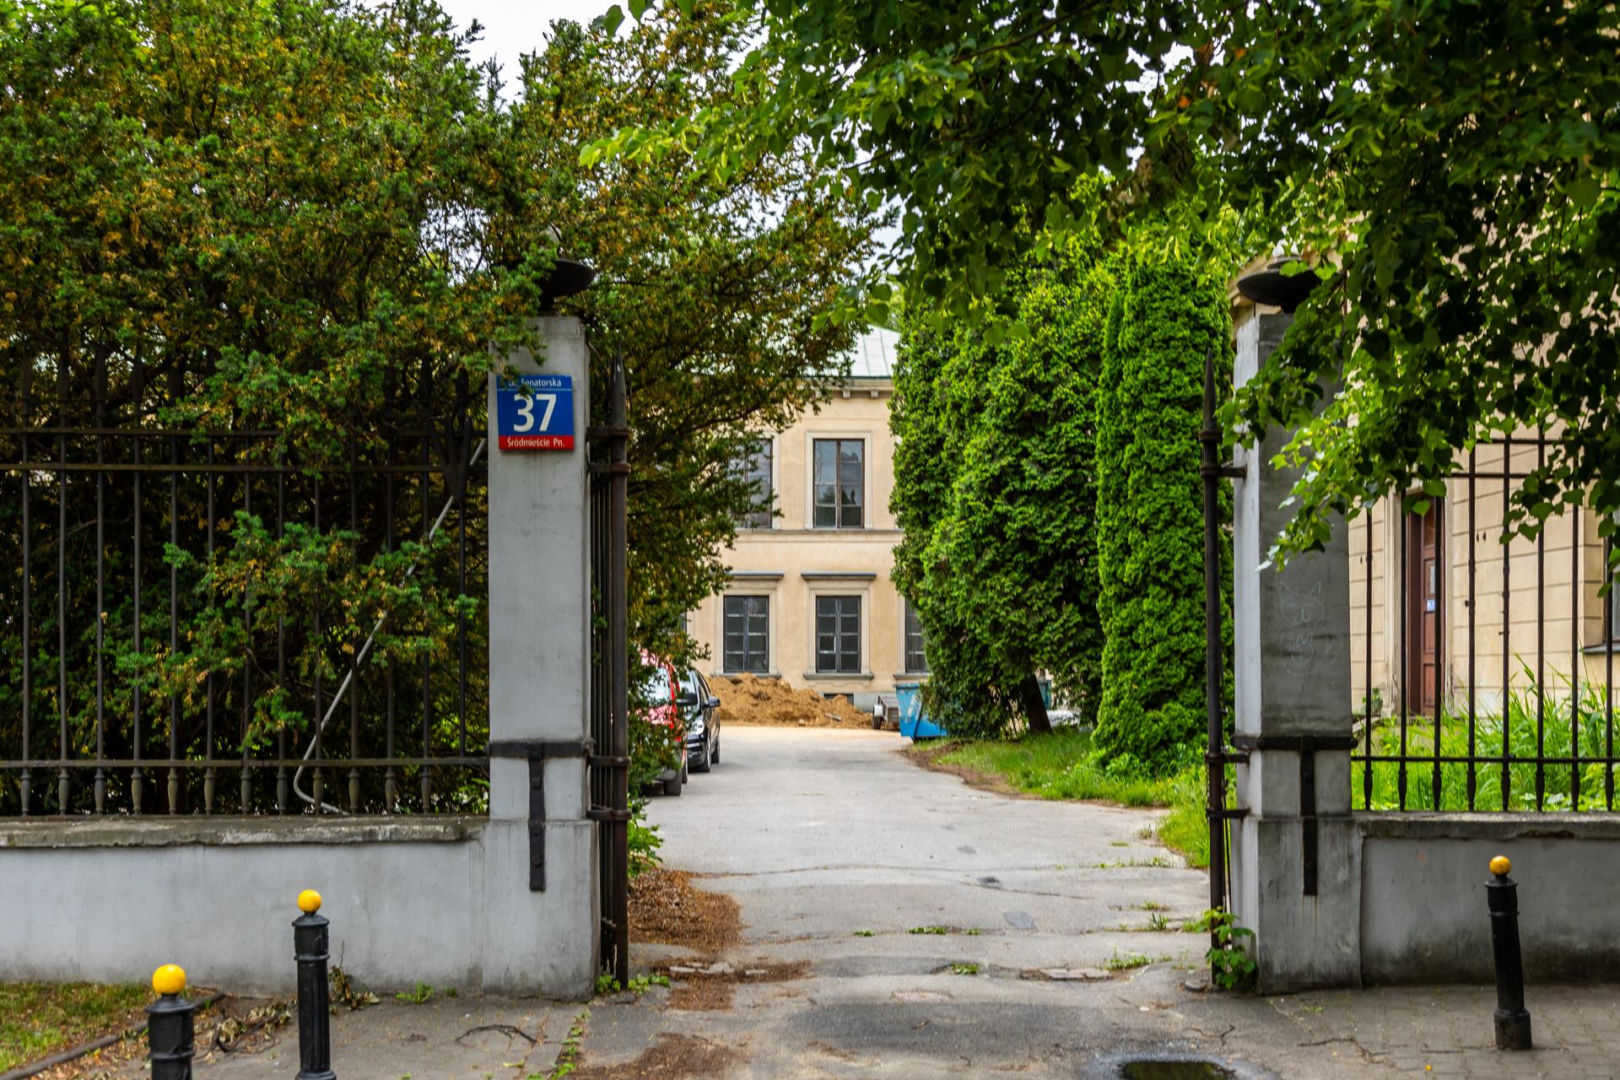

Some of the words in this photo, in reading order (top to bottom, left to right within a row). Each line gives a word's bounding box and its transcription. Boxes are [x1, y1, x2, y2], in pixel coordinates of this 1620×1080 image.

[513, 394, 557, 432] 37
[507, 436, 550, 448] Śródmieście
[553, 437, 566, 447] Pn.
